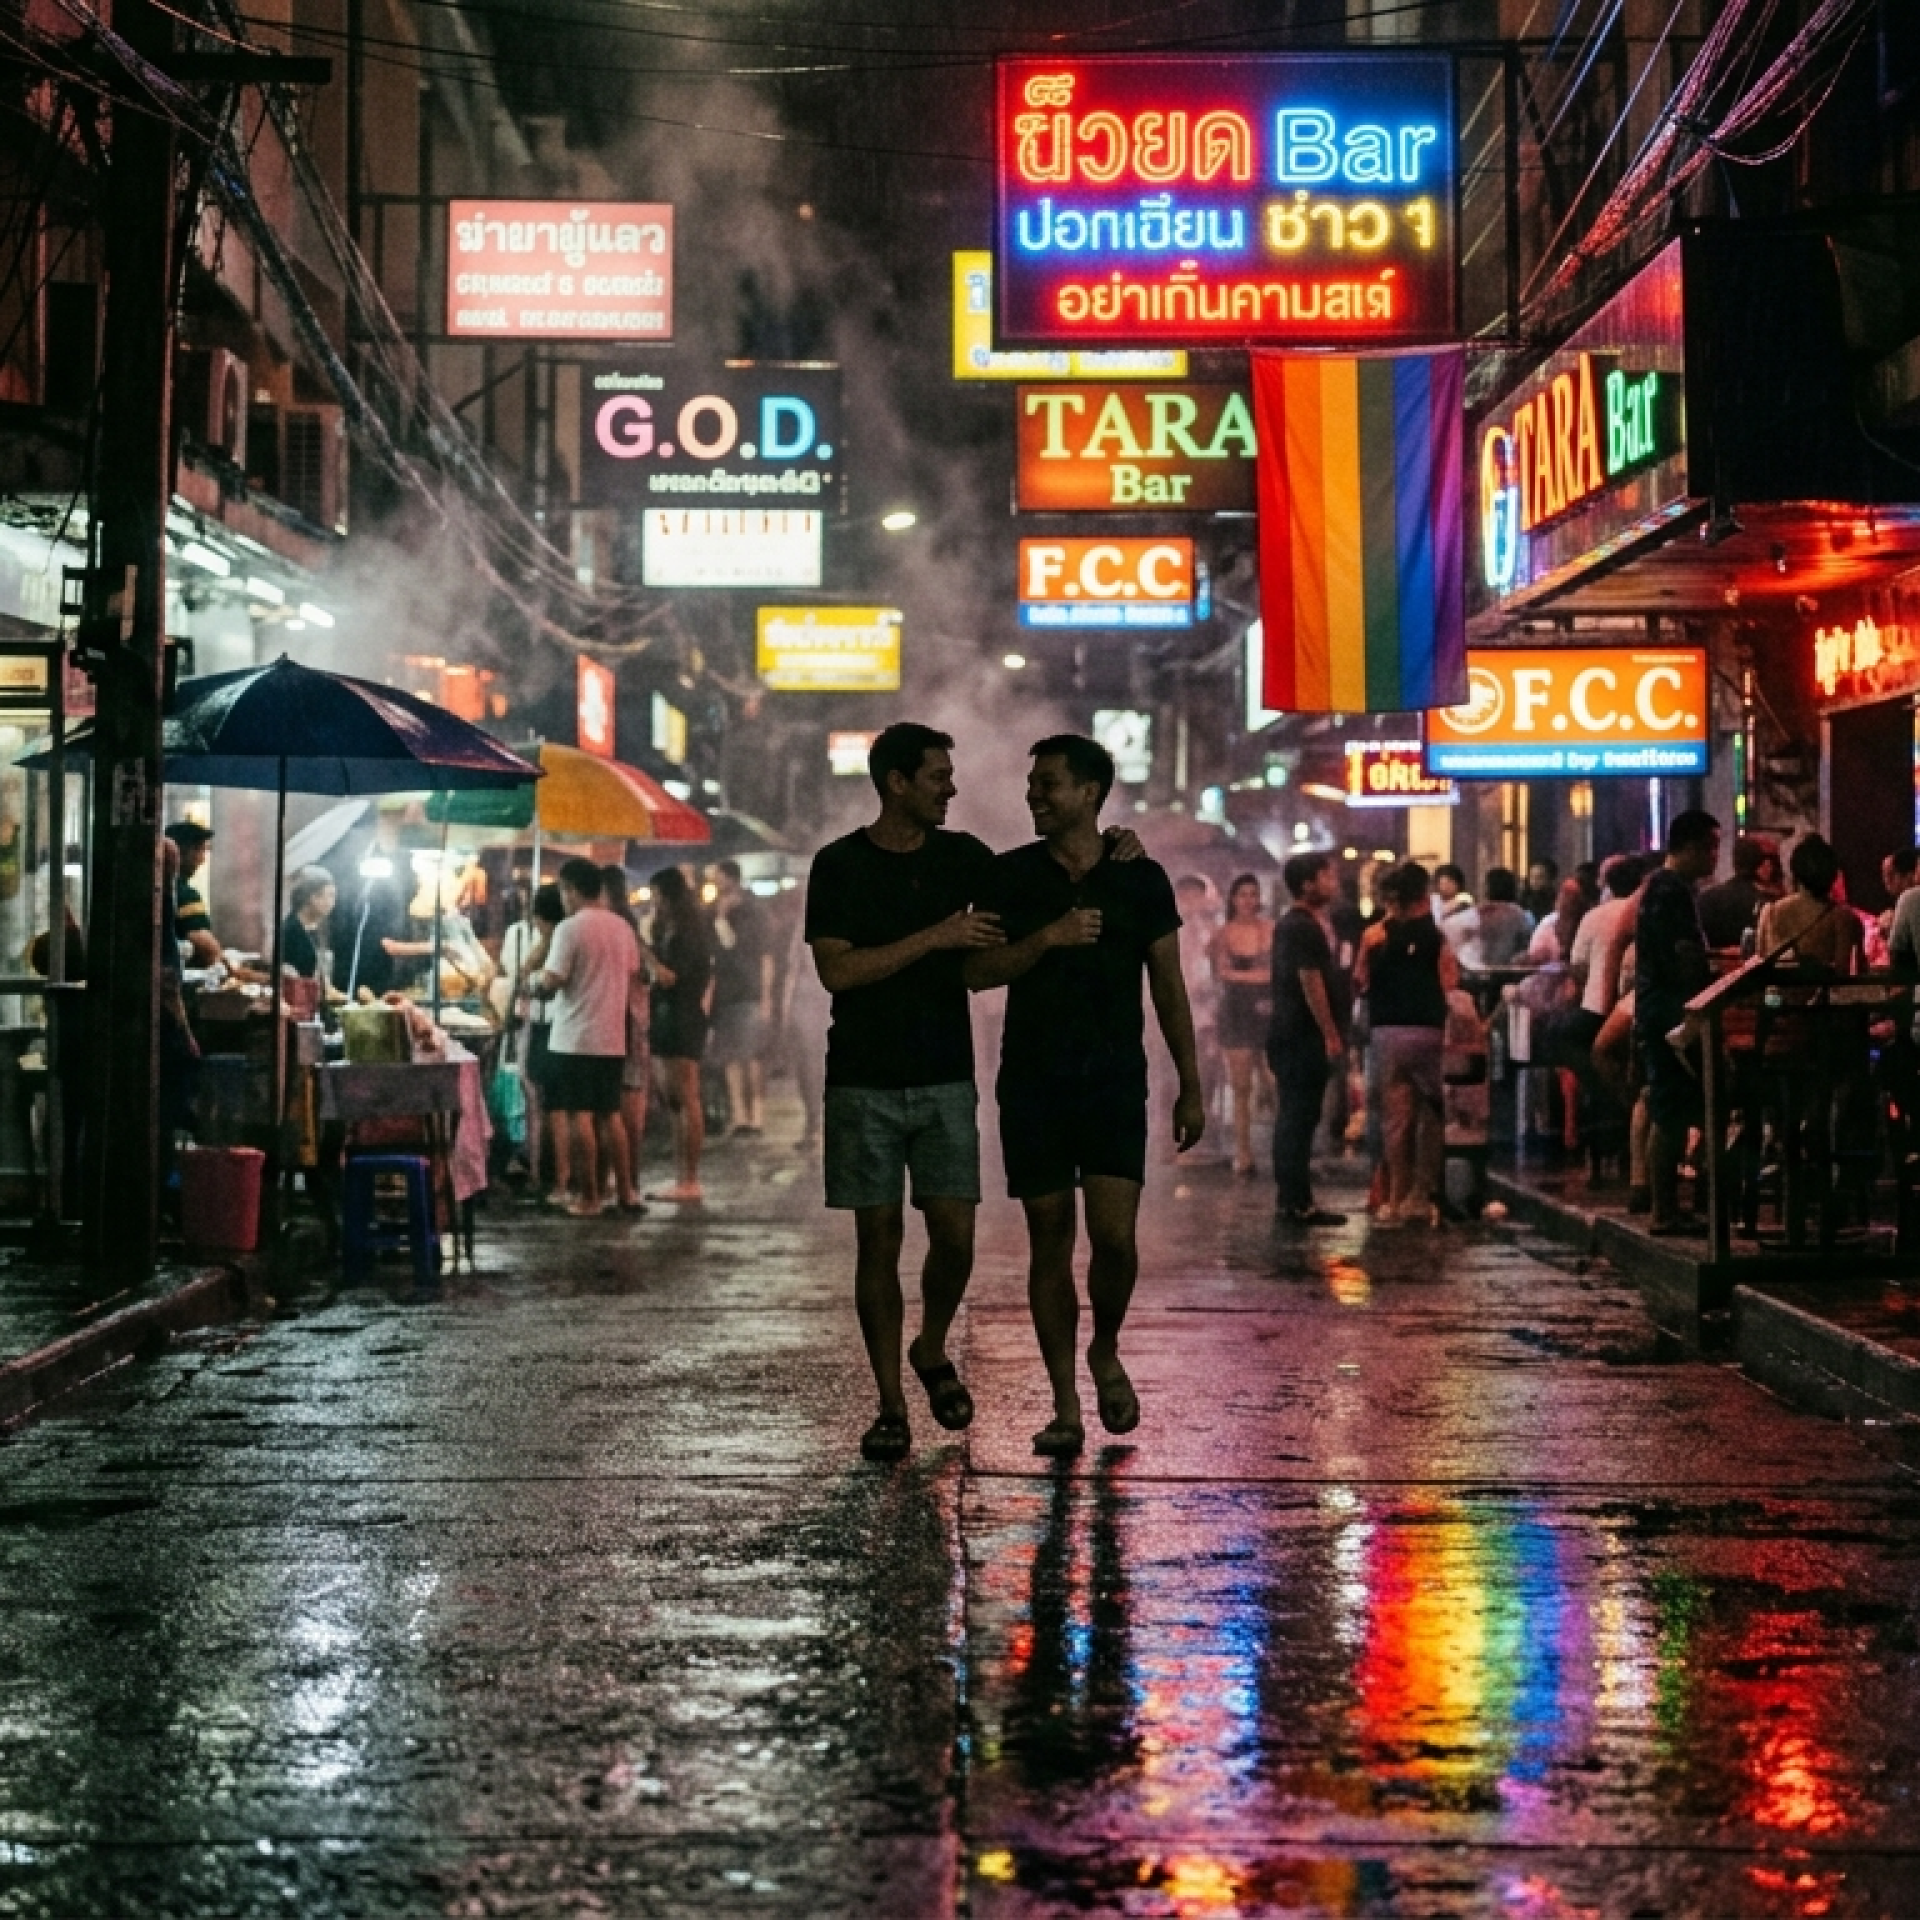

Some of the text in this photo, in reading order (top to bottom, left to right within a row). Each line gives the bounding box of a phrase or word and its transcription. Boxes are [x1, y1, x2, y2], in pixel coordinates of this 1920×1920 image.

[1276, 109, 1436, 182] Bar
[594, 394, 833, 460] G.O.D.
[1025, 392, 1257, 459] TARA
[1515, 351, 1658, 532] TARA Bar
[1109, 464, 1192, 504] Bar
[1026, 545, 1182, 598] F.C.C
[1512, 667, 1698, 731] F.C.C.
